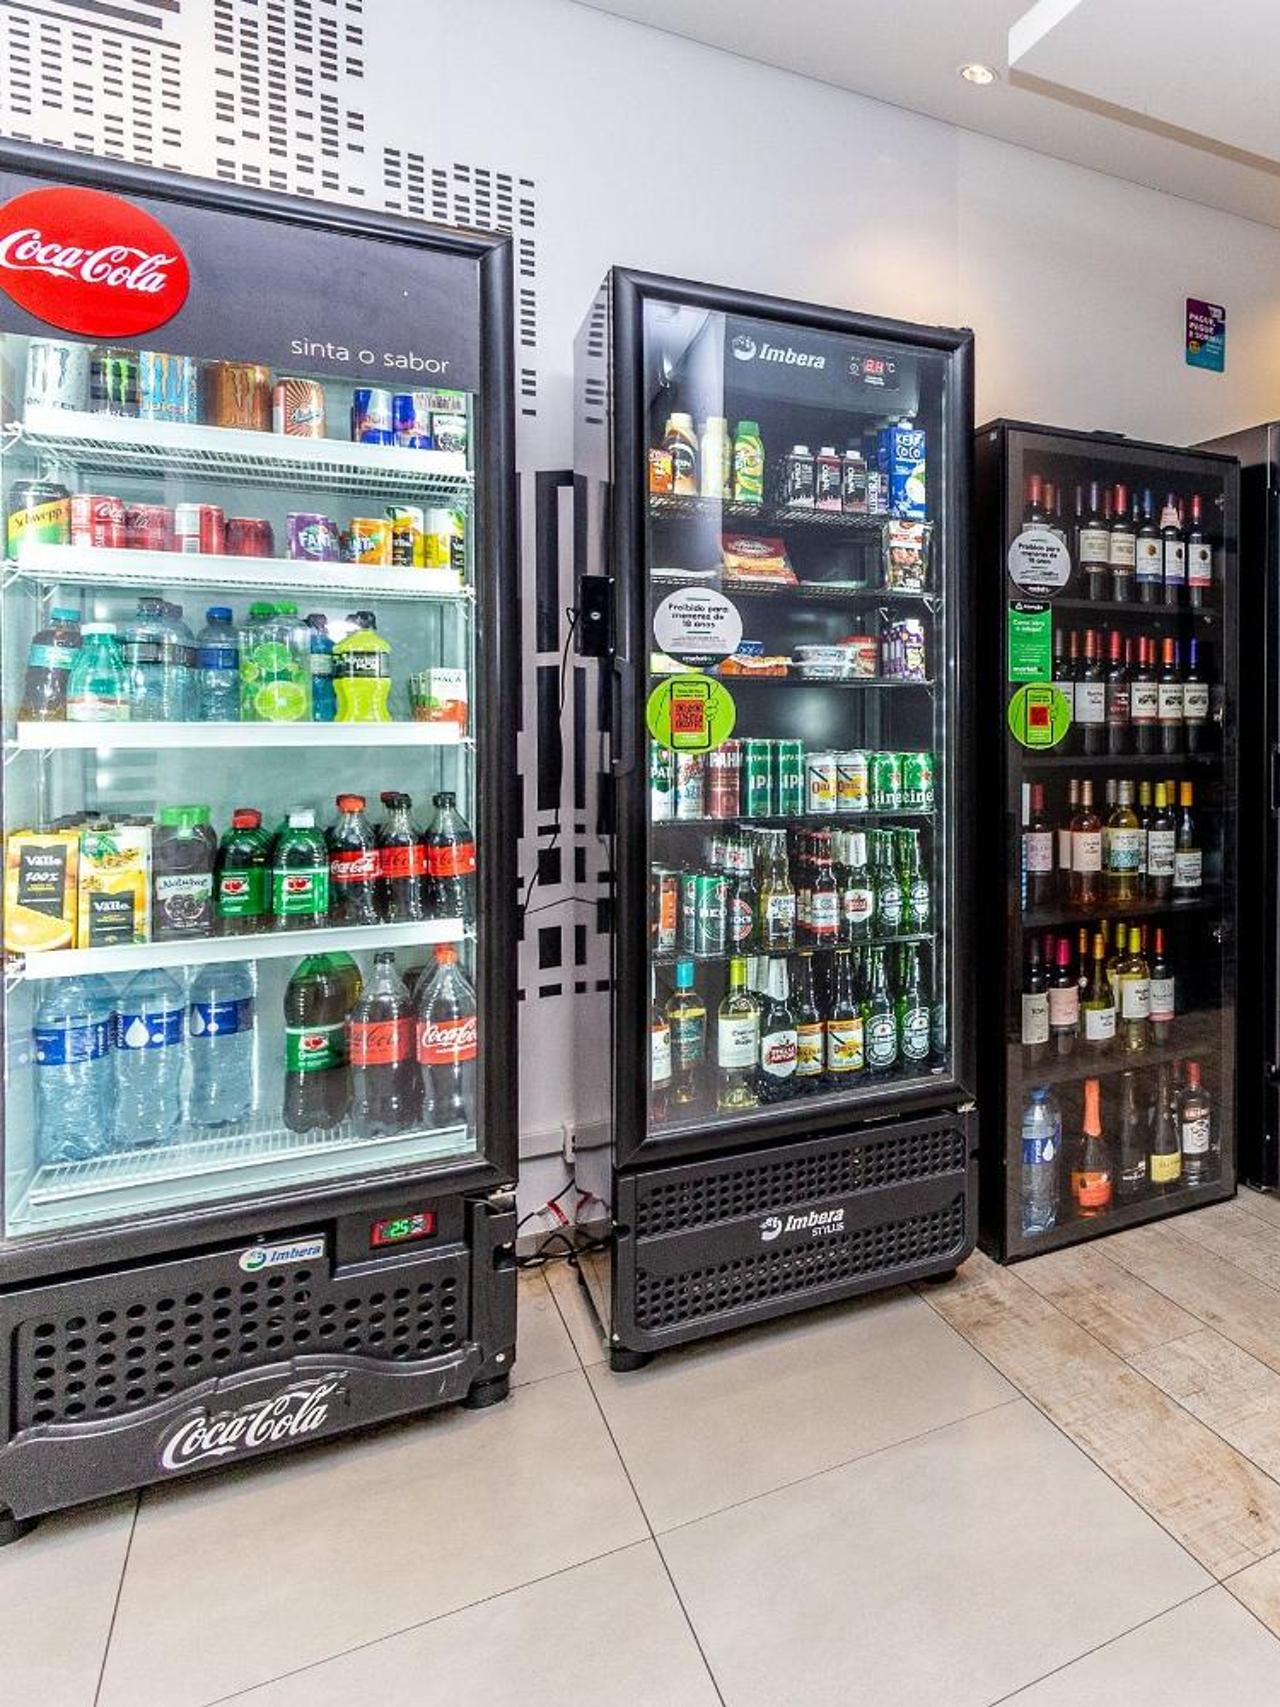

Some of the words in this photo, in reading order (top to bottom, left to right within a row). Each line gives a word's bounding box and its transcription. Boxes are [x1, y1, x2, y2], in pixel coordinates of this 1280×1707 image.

[0, 228, 177, 294] Coca-Cola
[291, 338, 349, 361] sinta
[358, 350, 375, 364] o
[384, 352, 450, 373] sabor
[758, 343, 826, 369] Imbera
[785, 1208, 844, 1232] Imbera
[270, 1245, 321, 1263] Imbera
[160, 1382, 334, 1470] Coca-Cola
